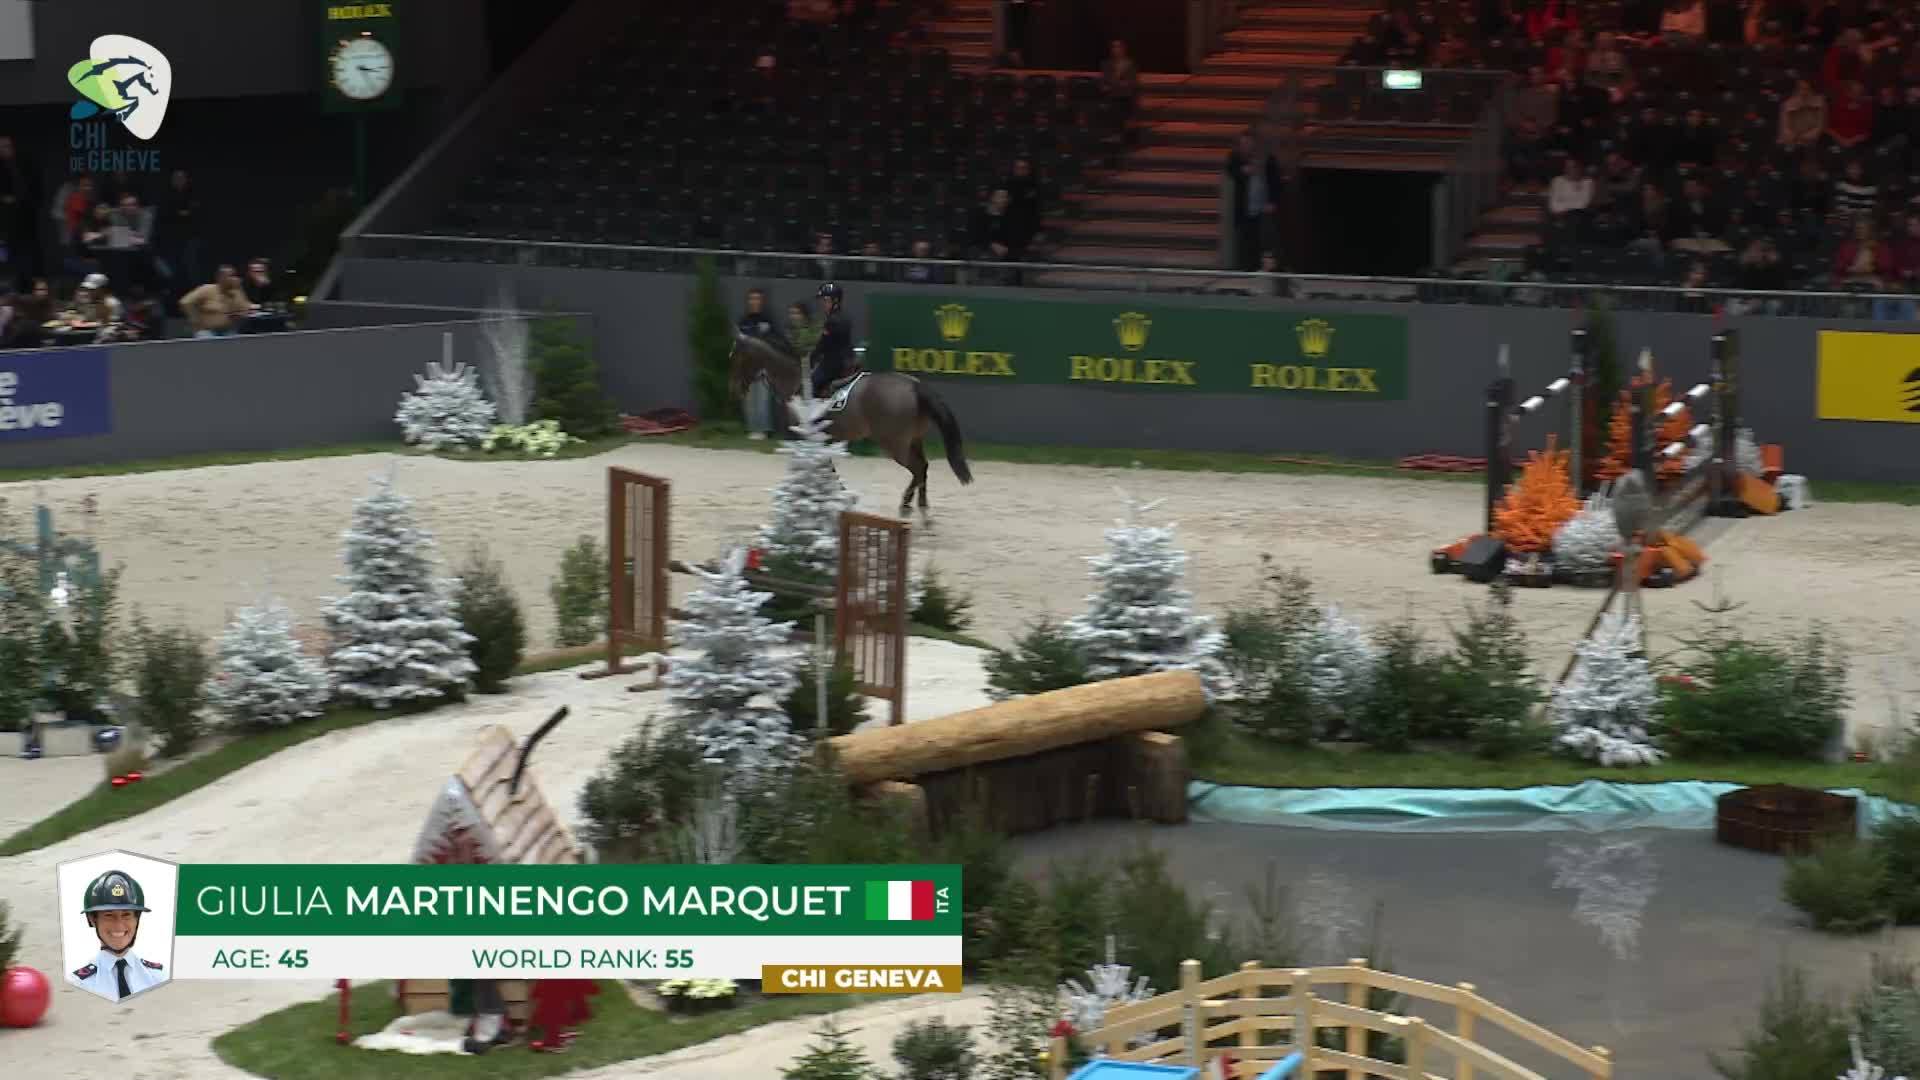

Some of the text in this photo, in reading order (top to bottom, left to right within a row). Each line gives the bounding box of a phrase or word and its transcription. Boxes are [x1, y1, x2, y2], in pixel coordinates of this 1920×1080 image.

[892, 348, 1015, 376] ROLEX
[1070, 355, 1196, 385] ROLEX
[1250, 363, 1379, 393] ROLEX
